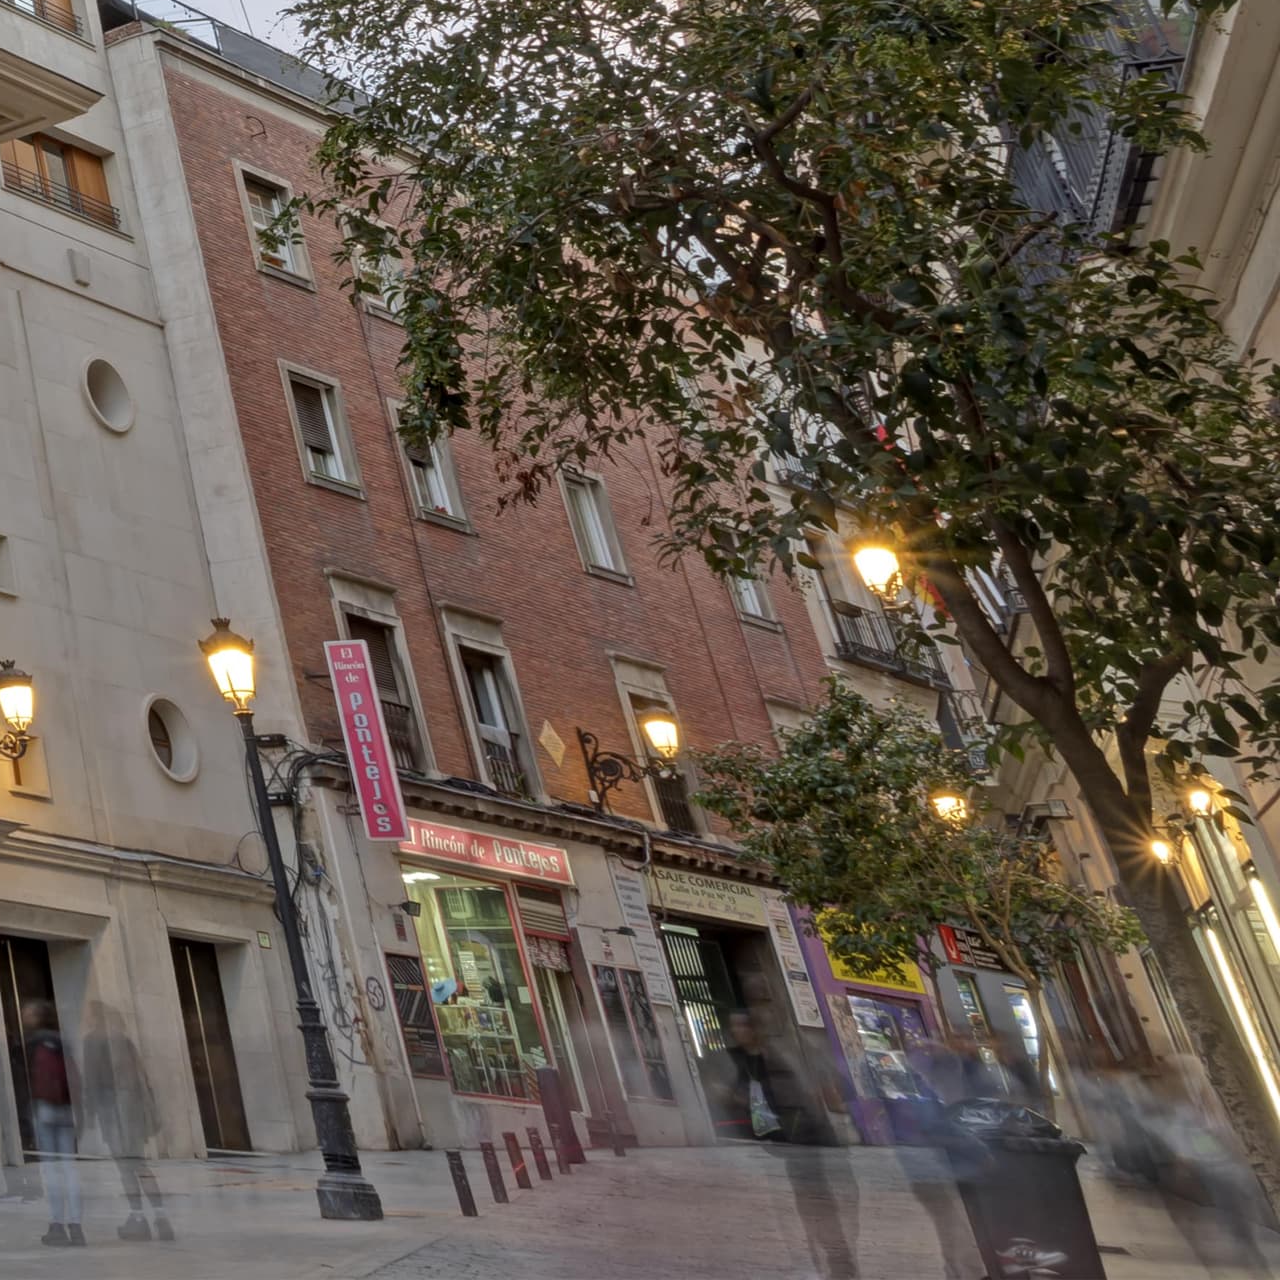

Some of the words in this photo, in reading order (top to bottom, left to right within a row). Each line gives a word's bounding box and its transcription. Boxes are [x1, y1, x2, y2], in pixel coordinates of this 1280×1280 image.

[345, 671, 360, 683] de
[420, 827, 465, 856] Rincón
[470, 839, 485, 859] de
[492, 839, 561, 876] Pontejos
[687, 874, 755, 898] COMERCIAL
